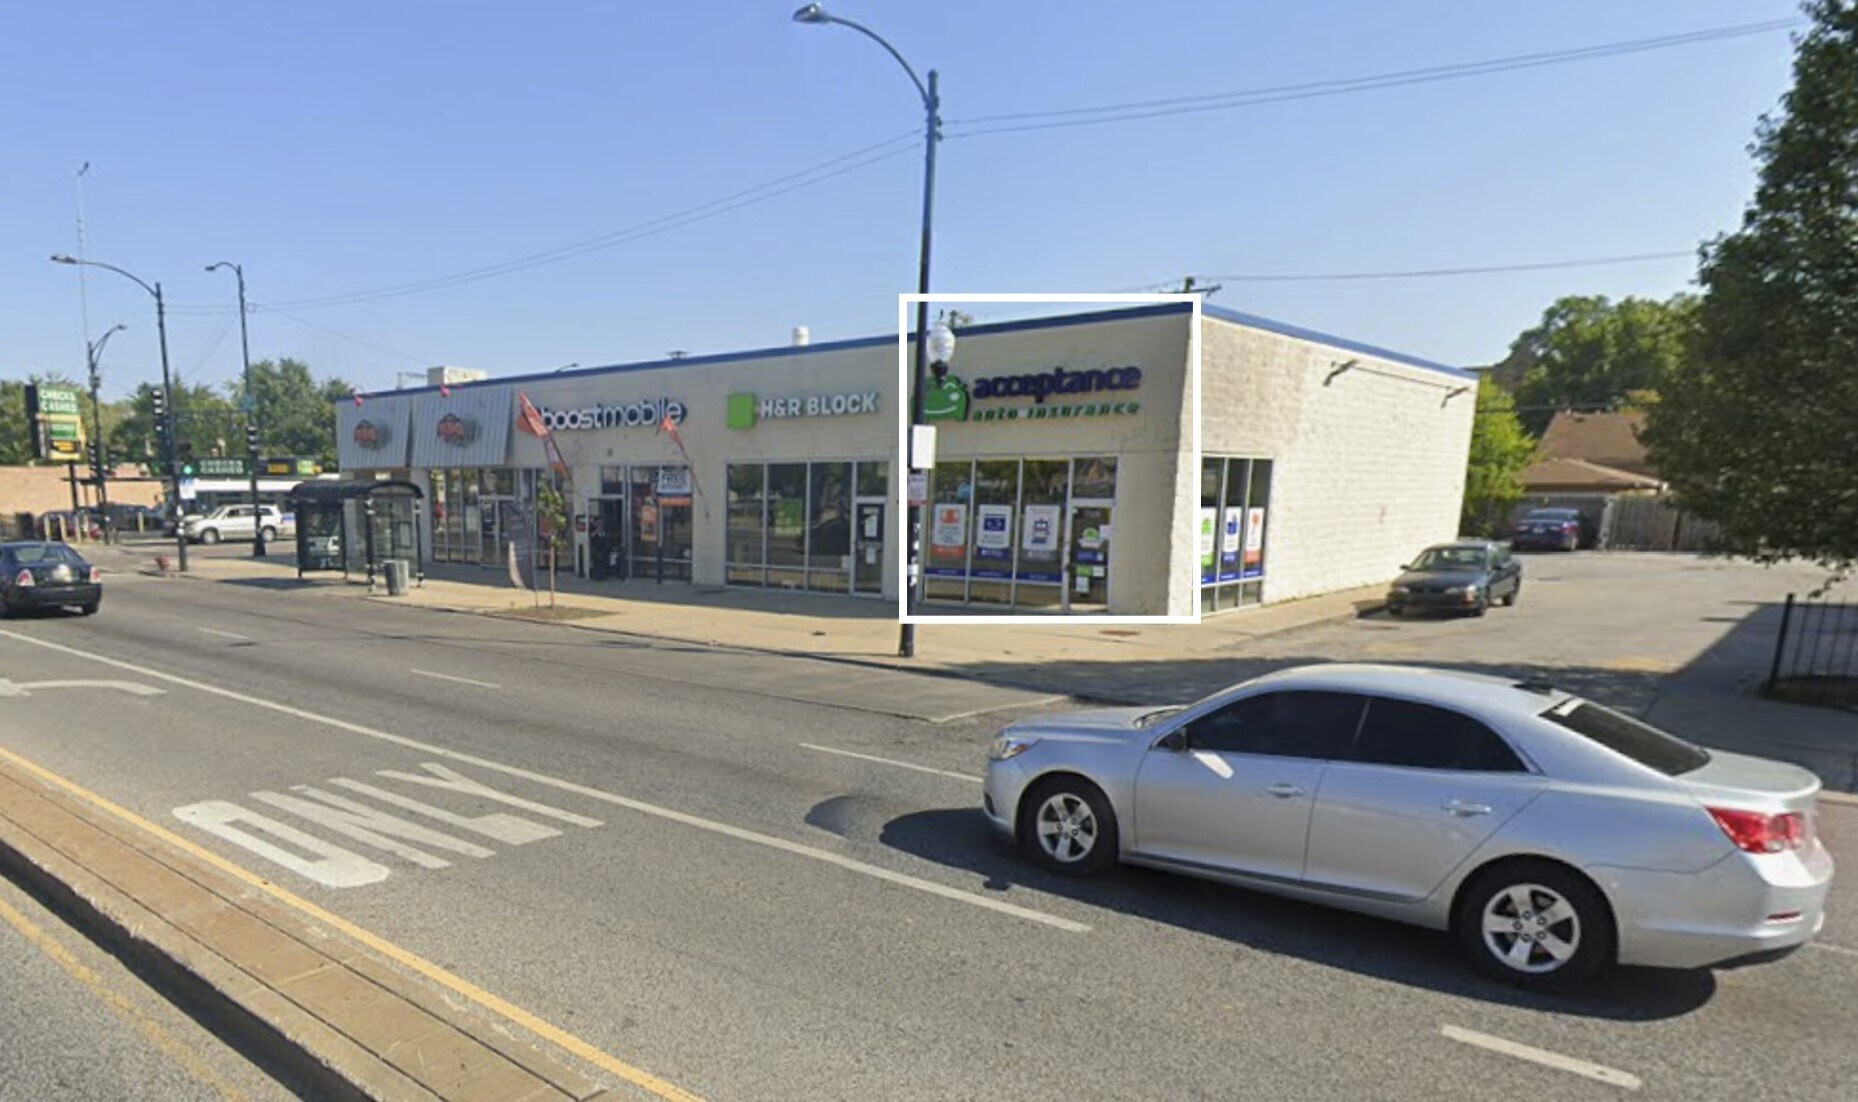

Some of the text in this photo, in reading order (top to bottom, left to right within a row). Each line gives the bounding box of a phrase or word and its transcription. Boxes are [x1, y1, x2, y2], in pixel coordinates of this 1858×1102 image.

[973, 366, 1141, 403] acceptance
[761, 391, 877, 419] H&R BLOCK
[973, 402, 1141, 421] auto insurance
[200, 466, 244, 475] CASHED
[171, 762, 604, 888] ONLY
